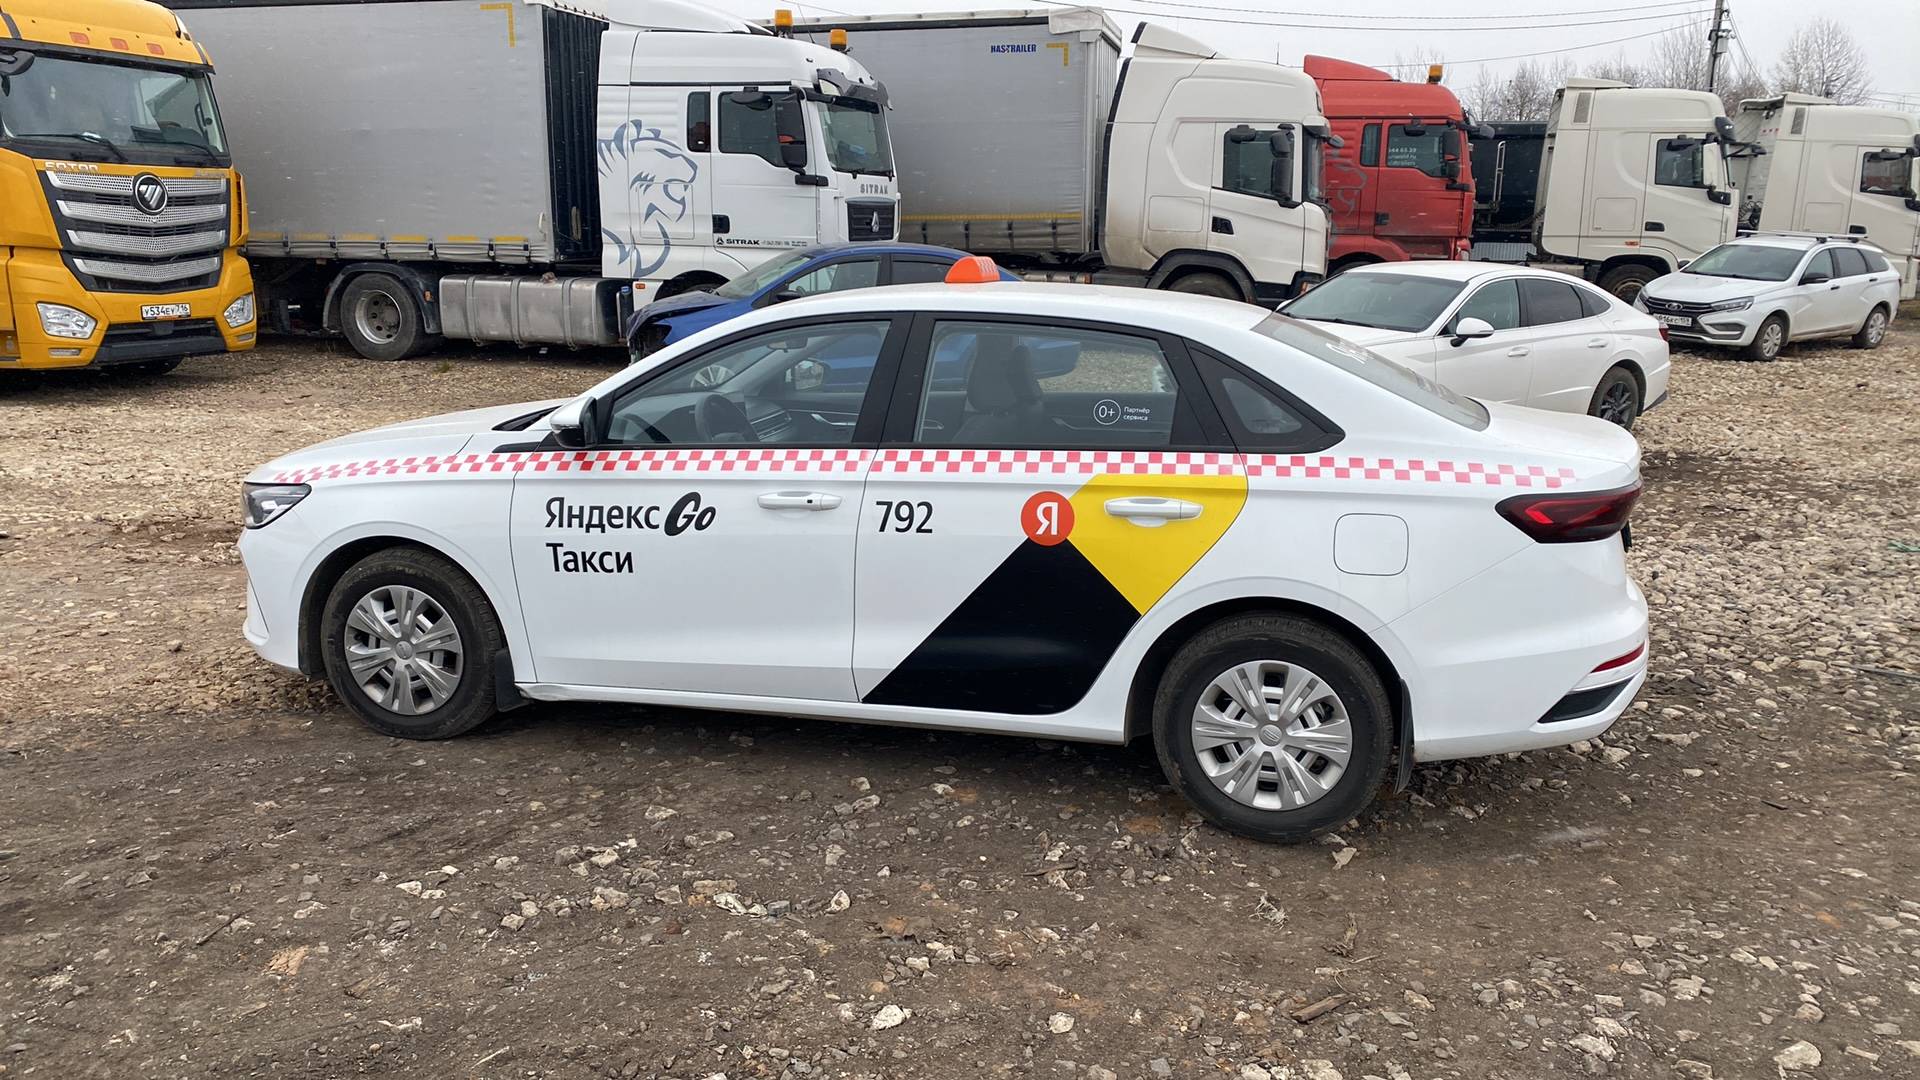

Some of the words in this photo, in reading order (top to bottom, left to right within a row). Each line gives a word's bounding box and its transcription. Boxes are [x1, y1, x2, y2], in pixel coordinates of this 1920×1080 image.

[860, 183, 888, 195] SITRAK
[1098, 405, 1116, 418] 0+
[1123, 406, 1151, 415] Партнёр
[545, 496, 660, 533] Яндекс
[664, 491, 717, 536] Go
[875, 500, 933, 533] 792
[1035, 501, 1060, 536] Я
[546, 542, 634, 573] Такси
